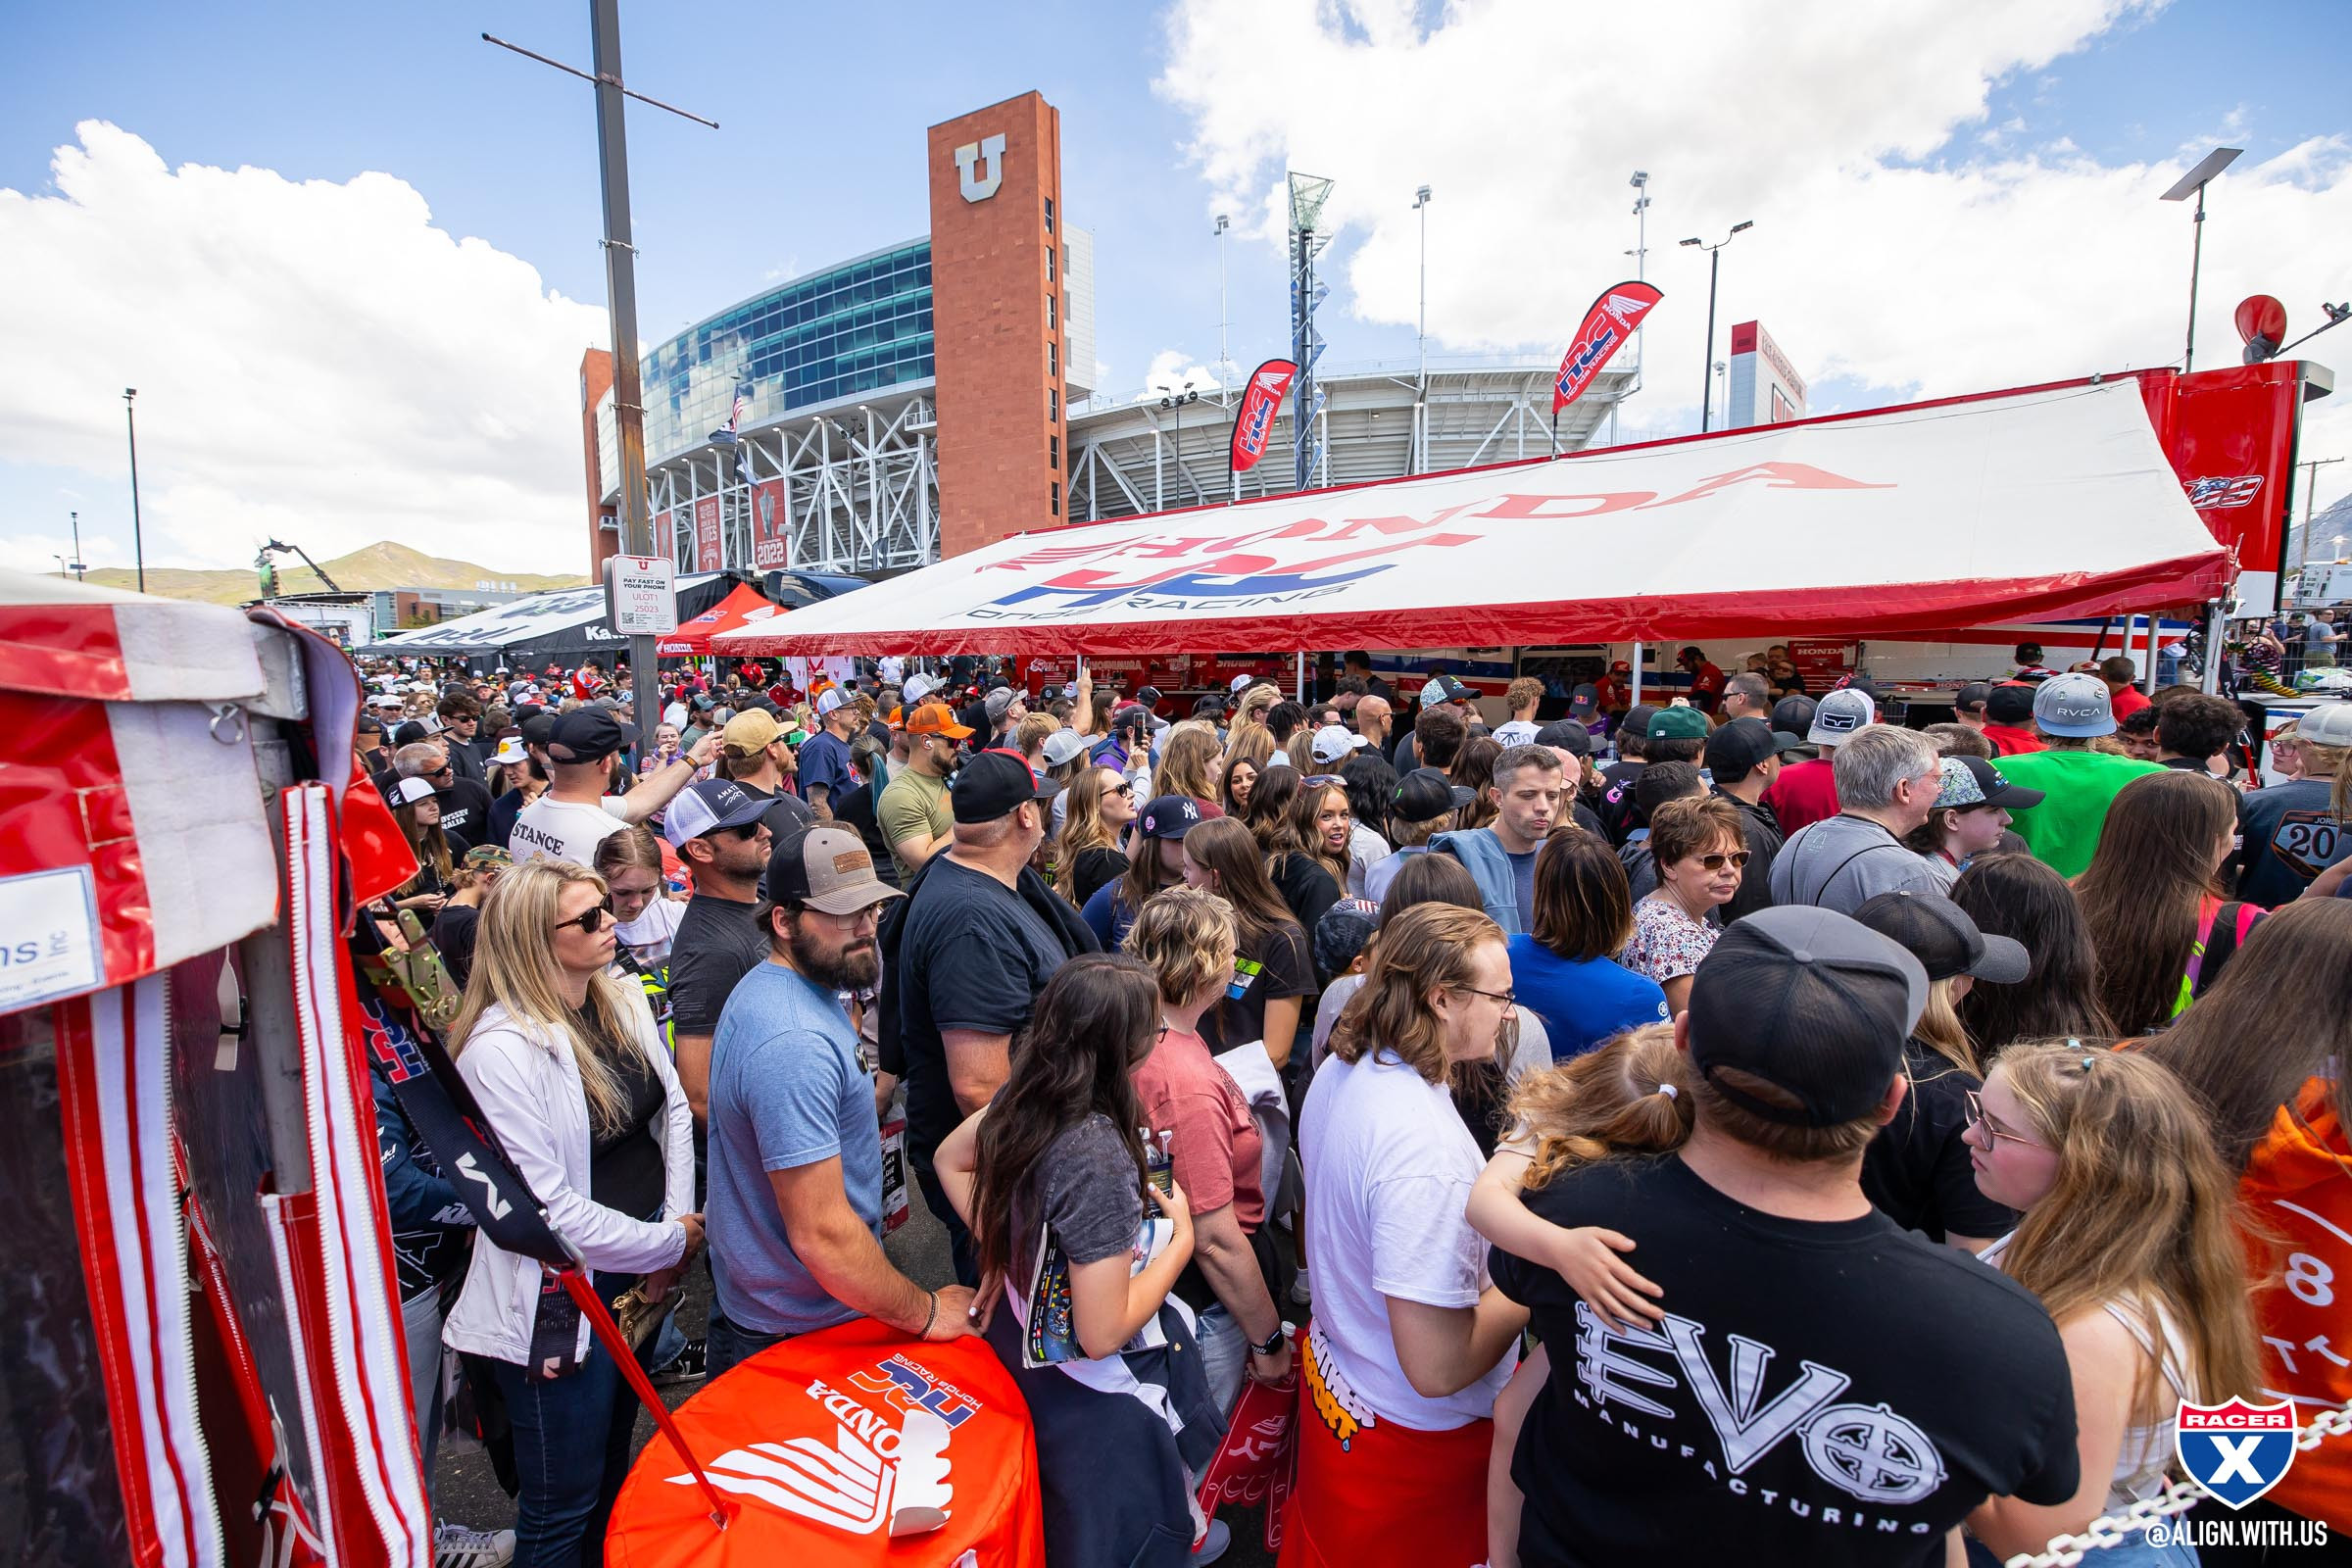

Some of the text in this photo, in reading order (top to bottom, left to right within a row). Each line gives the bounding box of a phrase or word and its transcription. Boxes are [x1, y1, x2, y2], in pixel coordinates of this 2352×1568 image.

[955, 132, 1006, 204] U
[1601, 303, 1632, 331] HONDA
[1555, 313, 1615, 398] HRC
[1566, 334, 1619, 401] Honda RACING
[1255, 379, 1282, 397] HONDA
[1114, 461, 1898, 559] HONDA
[638, 562, 649, 571] U
[757, 542, 784, 565] 2022
[634, 605, 660, 613] 25023
[1124, 582, 1357, 611] RACING
[663, 643, 693, 653] HONDA
[2057, 707, 2101, 717] RVCA
[440, 808, 469, 823] DYSSEY
[512, 821, 564, 857] STANCE
[2289, 824, 2336, 859] 20
[891, 1351, 983, 1411] Honda RACING
[1575, 1299, 1949, 1506] EVO
[804, 1378, 901, 1464] ONDA
[1573, 1388, 1931, 1535] MANUFACTURING
